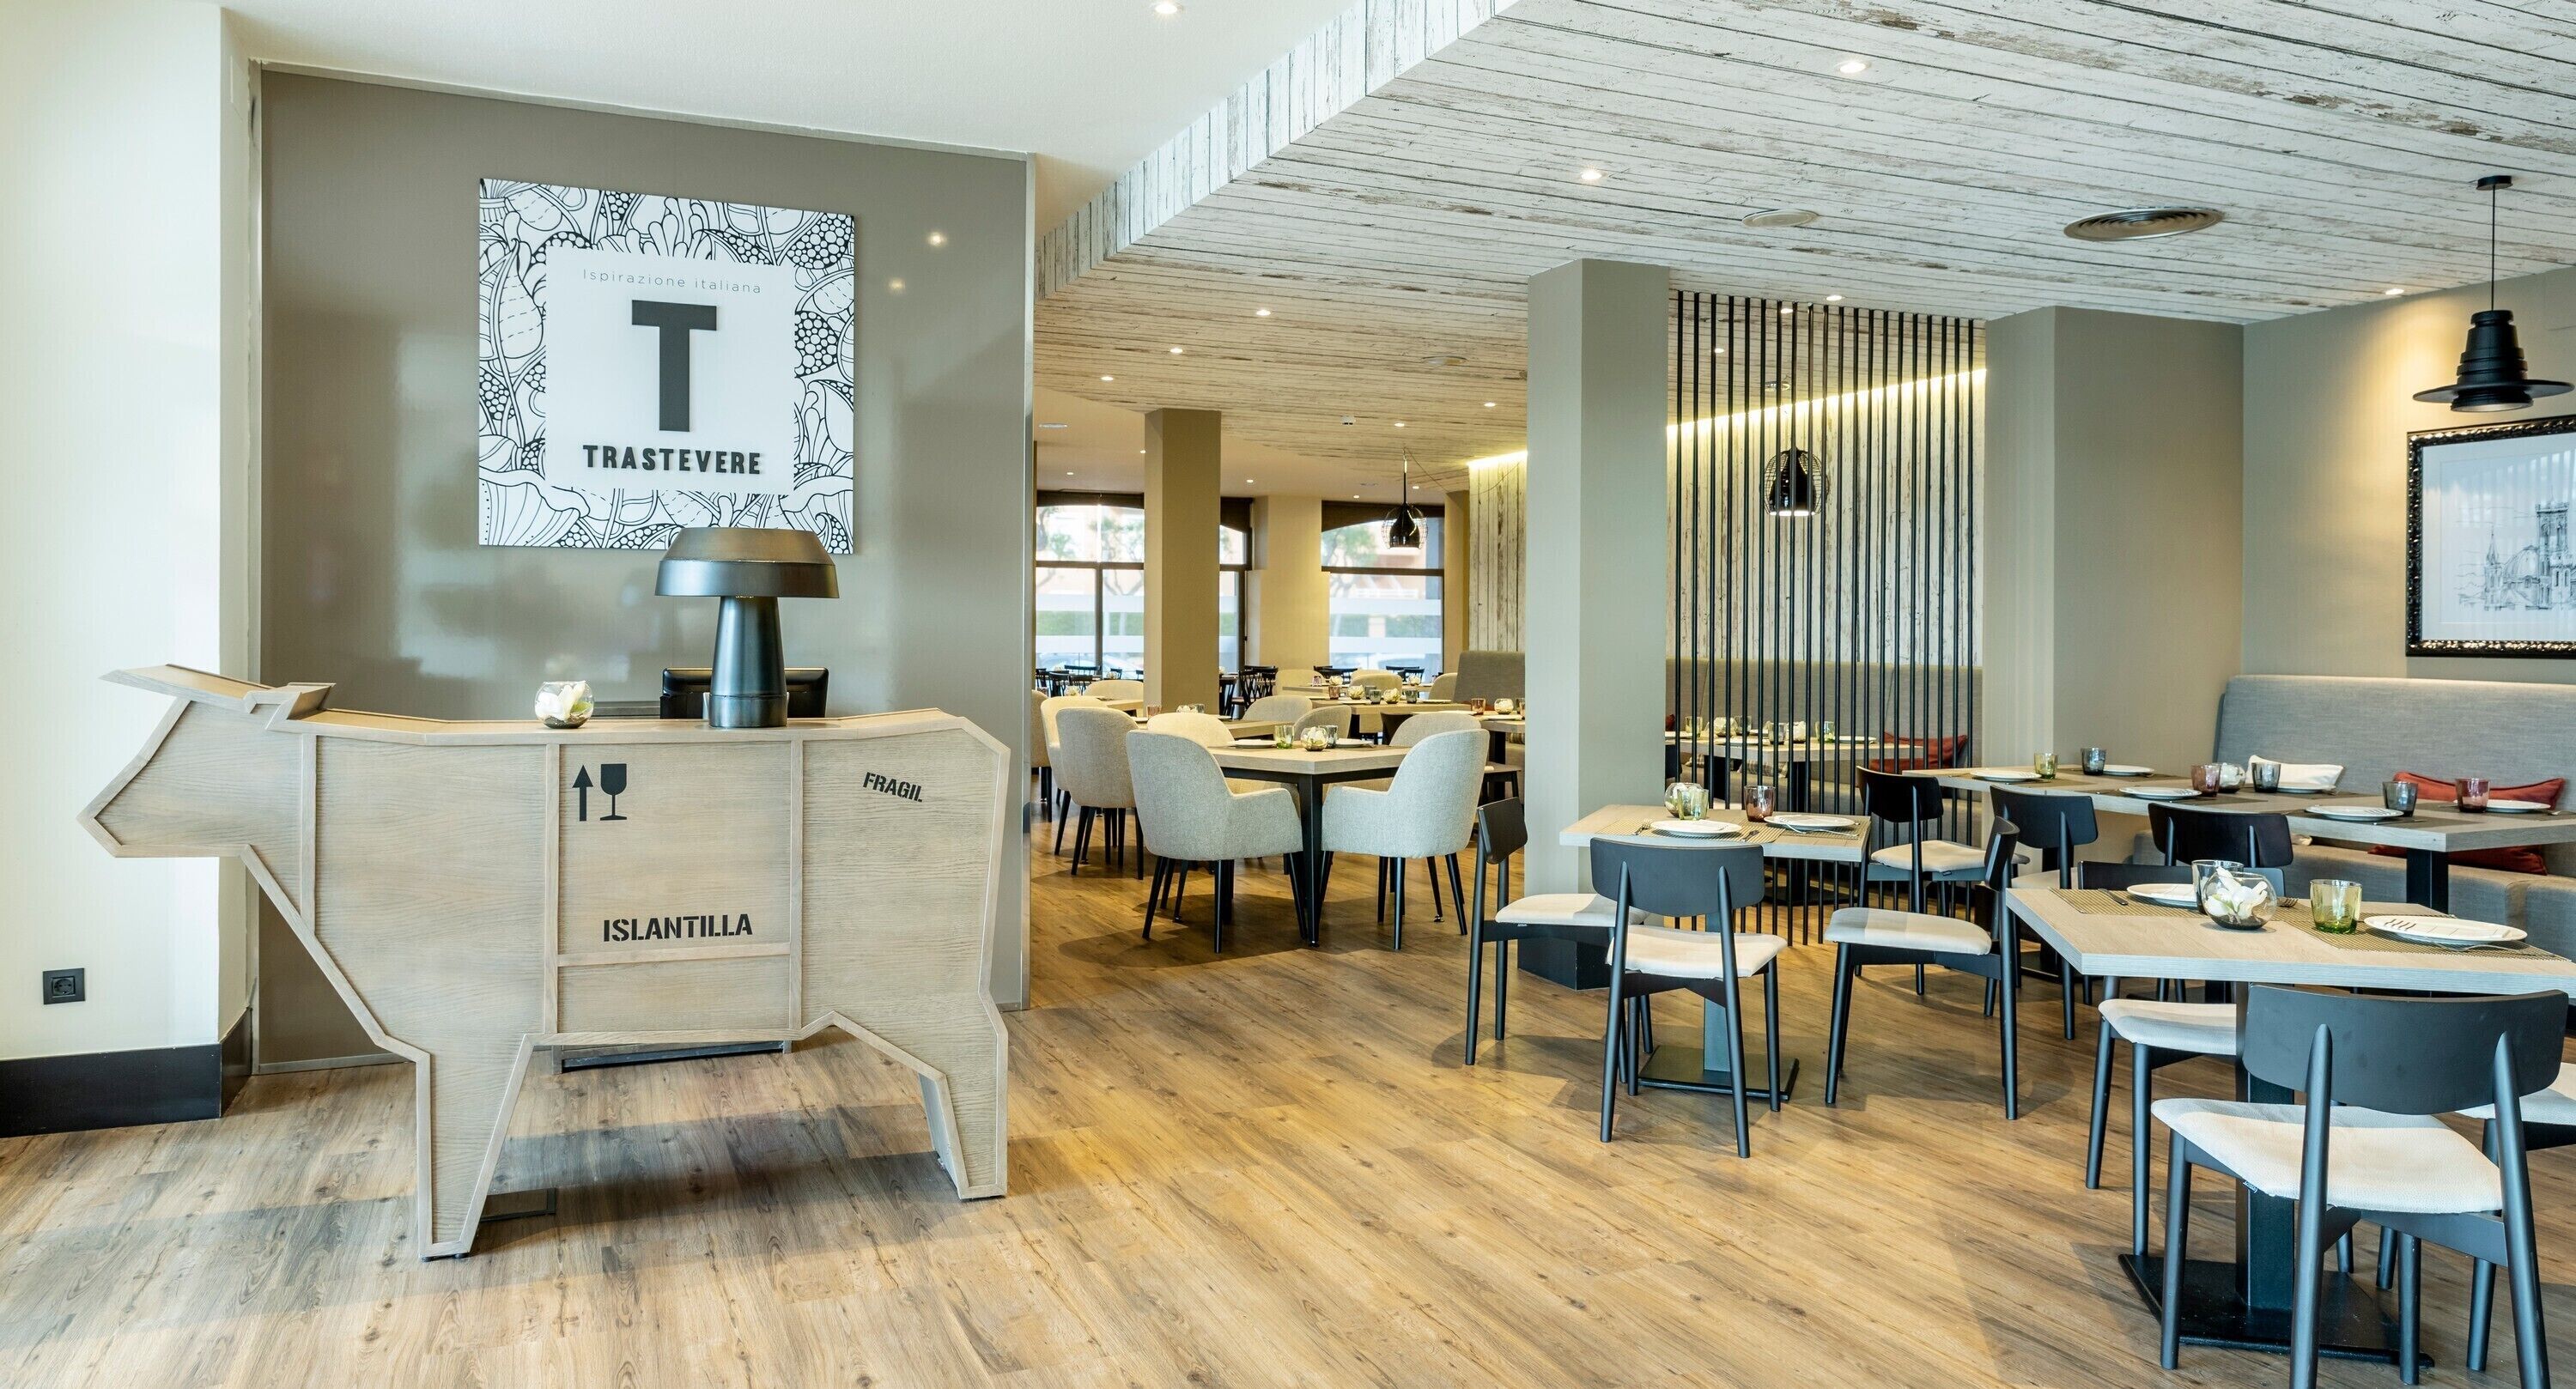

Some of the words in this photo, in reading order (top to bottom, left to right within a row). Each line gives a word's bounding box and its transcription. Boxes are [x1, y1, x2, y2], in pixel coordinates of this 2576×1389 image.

[583, 269, 685, 288] Ispirazione
[695, 278, 762, 294] italiana
[632, 300, 717, 433] T
[582, 445, 761, 475] TRASTEVERE
[862, 772, 923, 804] FRAGIL
[604, 913, 753, 943] ISLANTILLA
